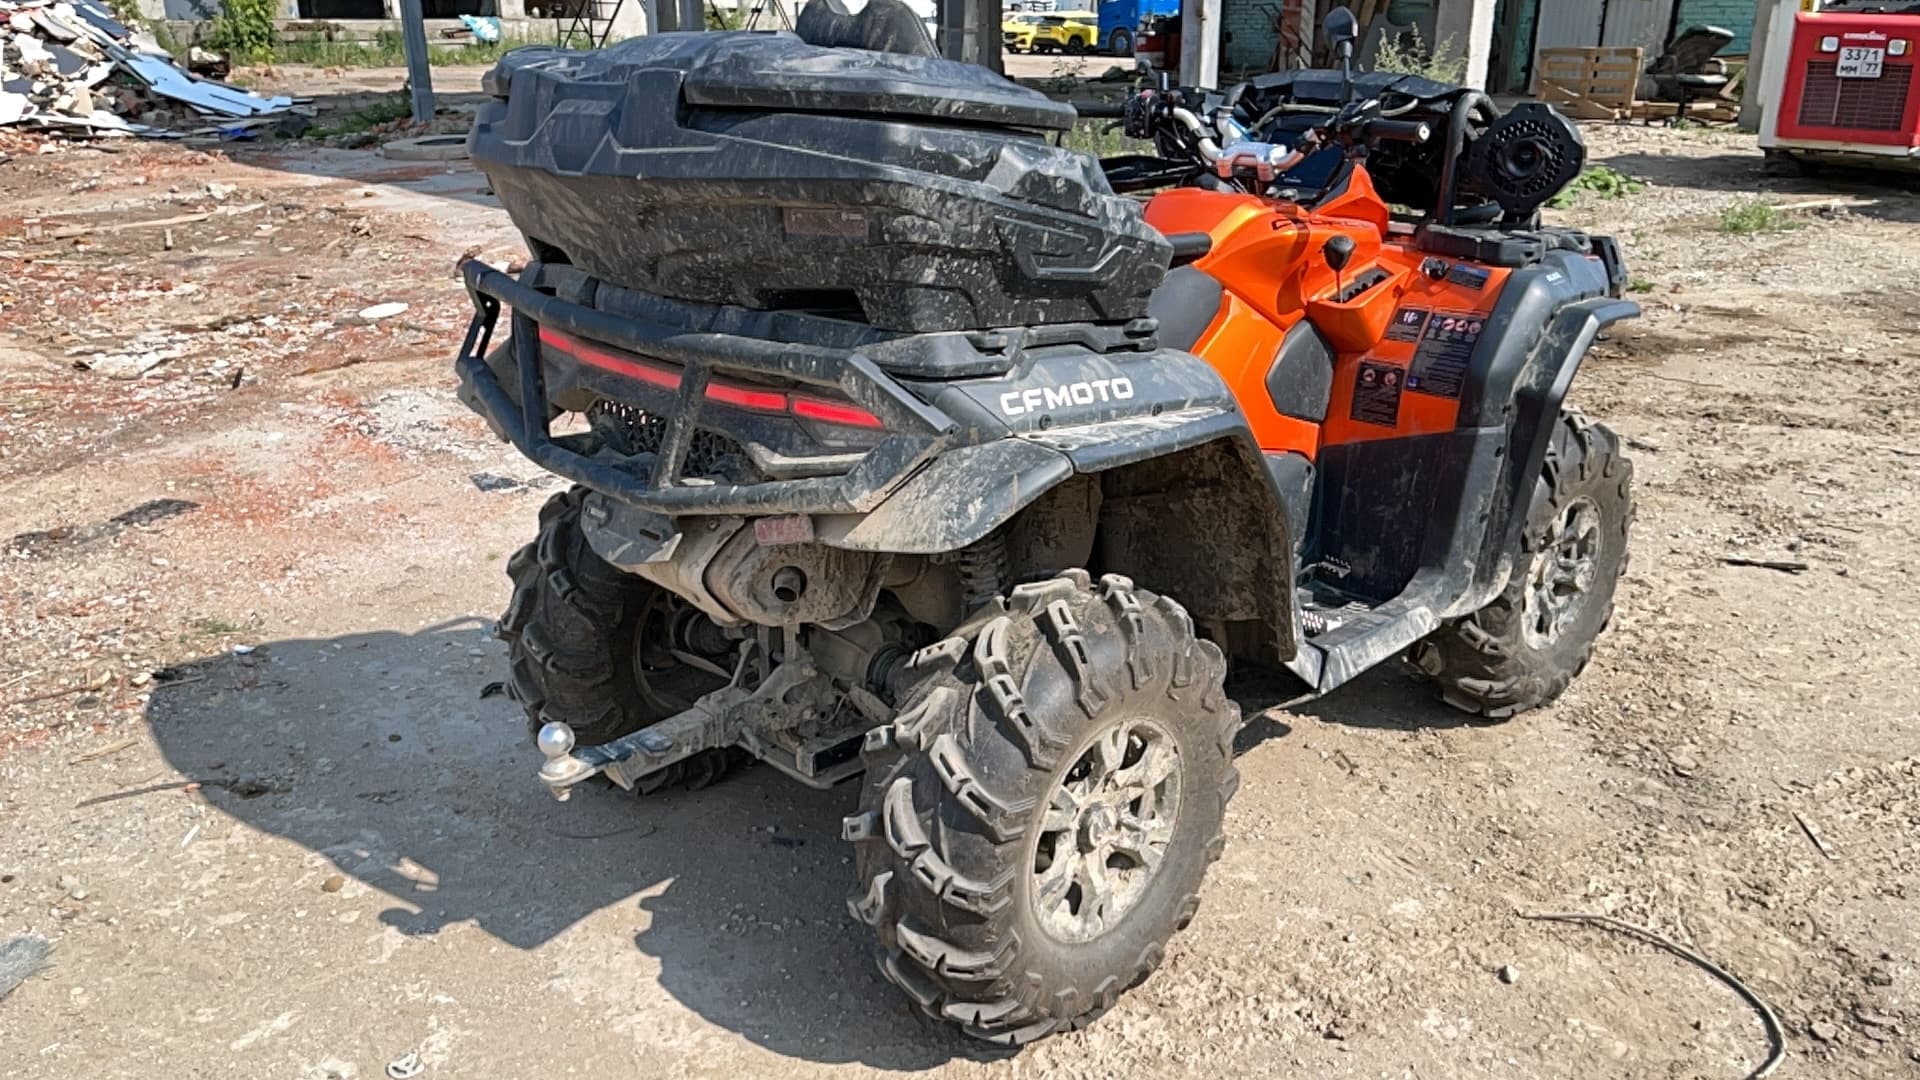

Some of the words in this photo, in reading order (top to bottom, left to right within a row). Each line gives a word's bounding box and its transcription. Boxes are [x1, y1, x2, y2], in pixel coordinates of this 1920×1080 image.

[1845, 48, 1879, 61] 3371
[1865, 62, 1879, 72] 77
[1000, 377, 1134, 416] CFMOTO
